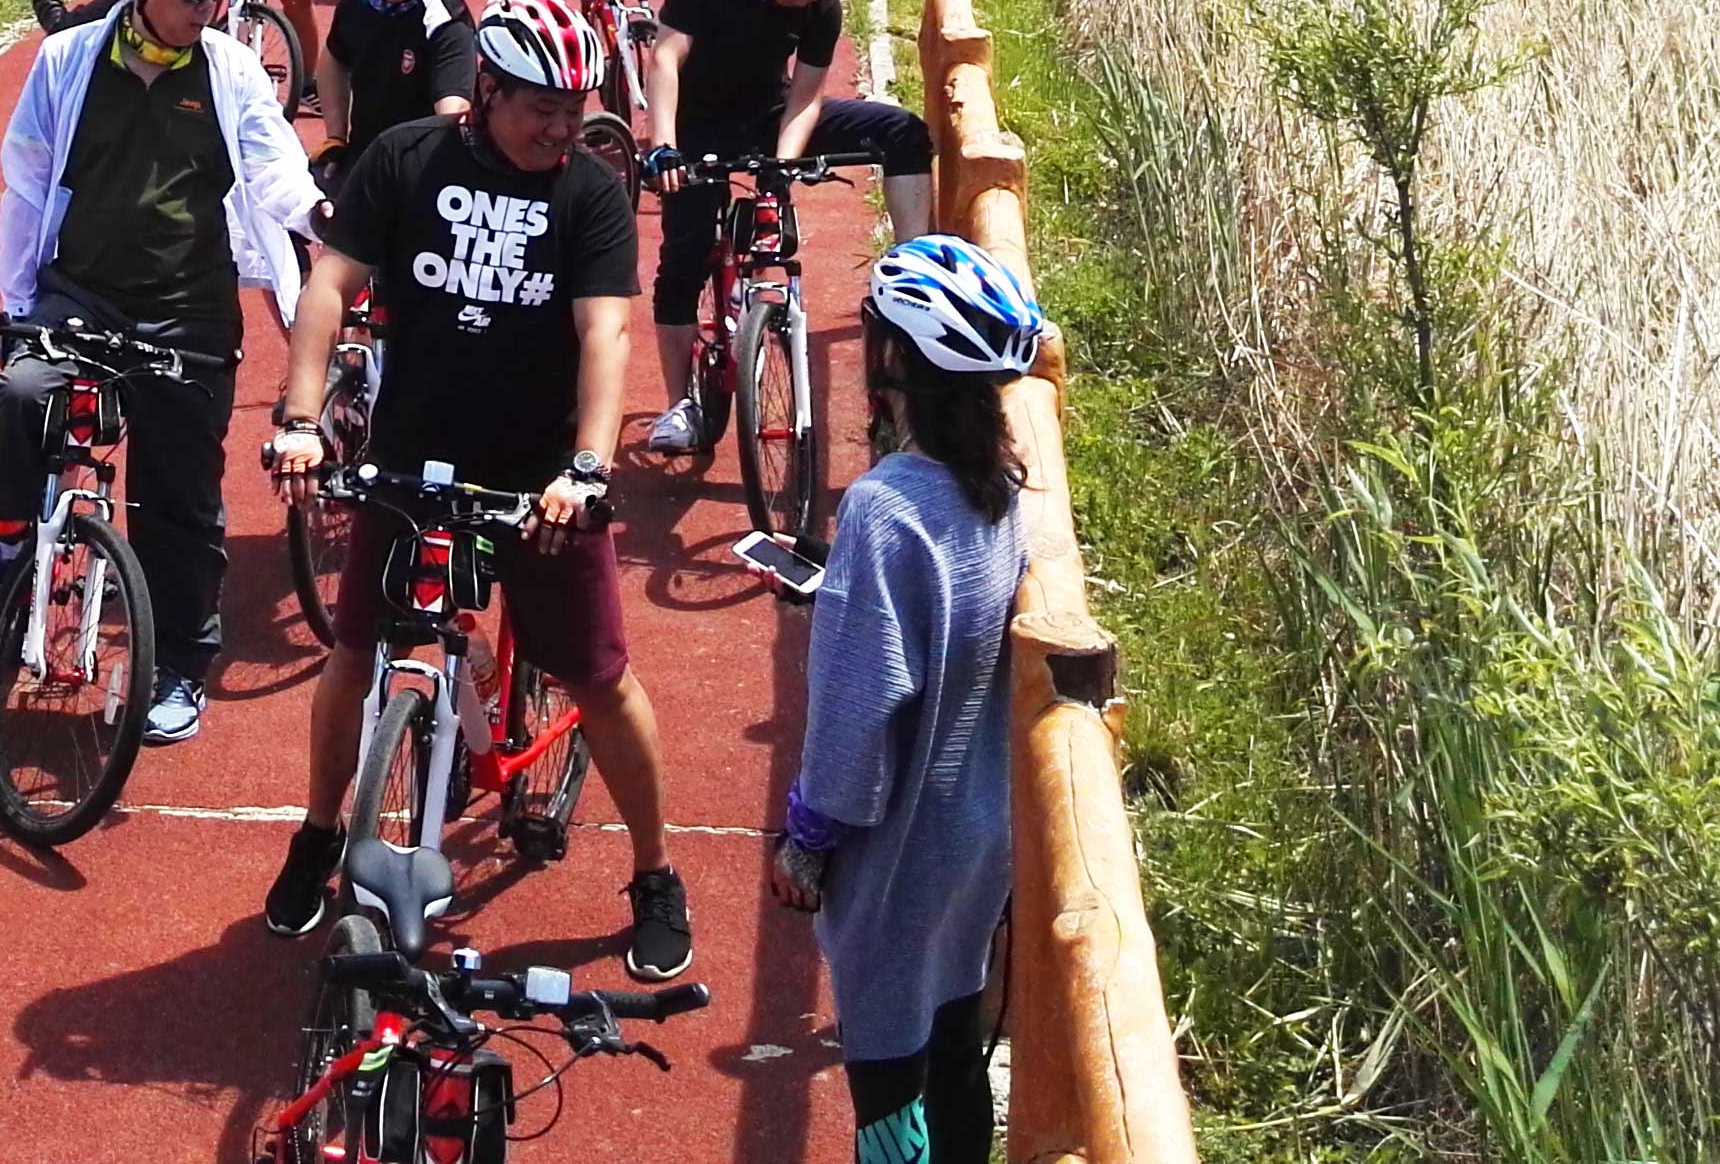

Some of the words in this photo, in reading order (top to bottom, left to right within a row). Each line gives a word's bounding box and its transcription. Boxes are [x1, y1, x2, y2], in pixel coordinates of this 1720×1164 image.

[437, 185, 548, 236] ONES
[451, 223, 527, 269] THE
[413, 252, 554, 305] ONLY#
